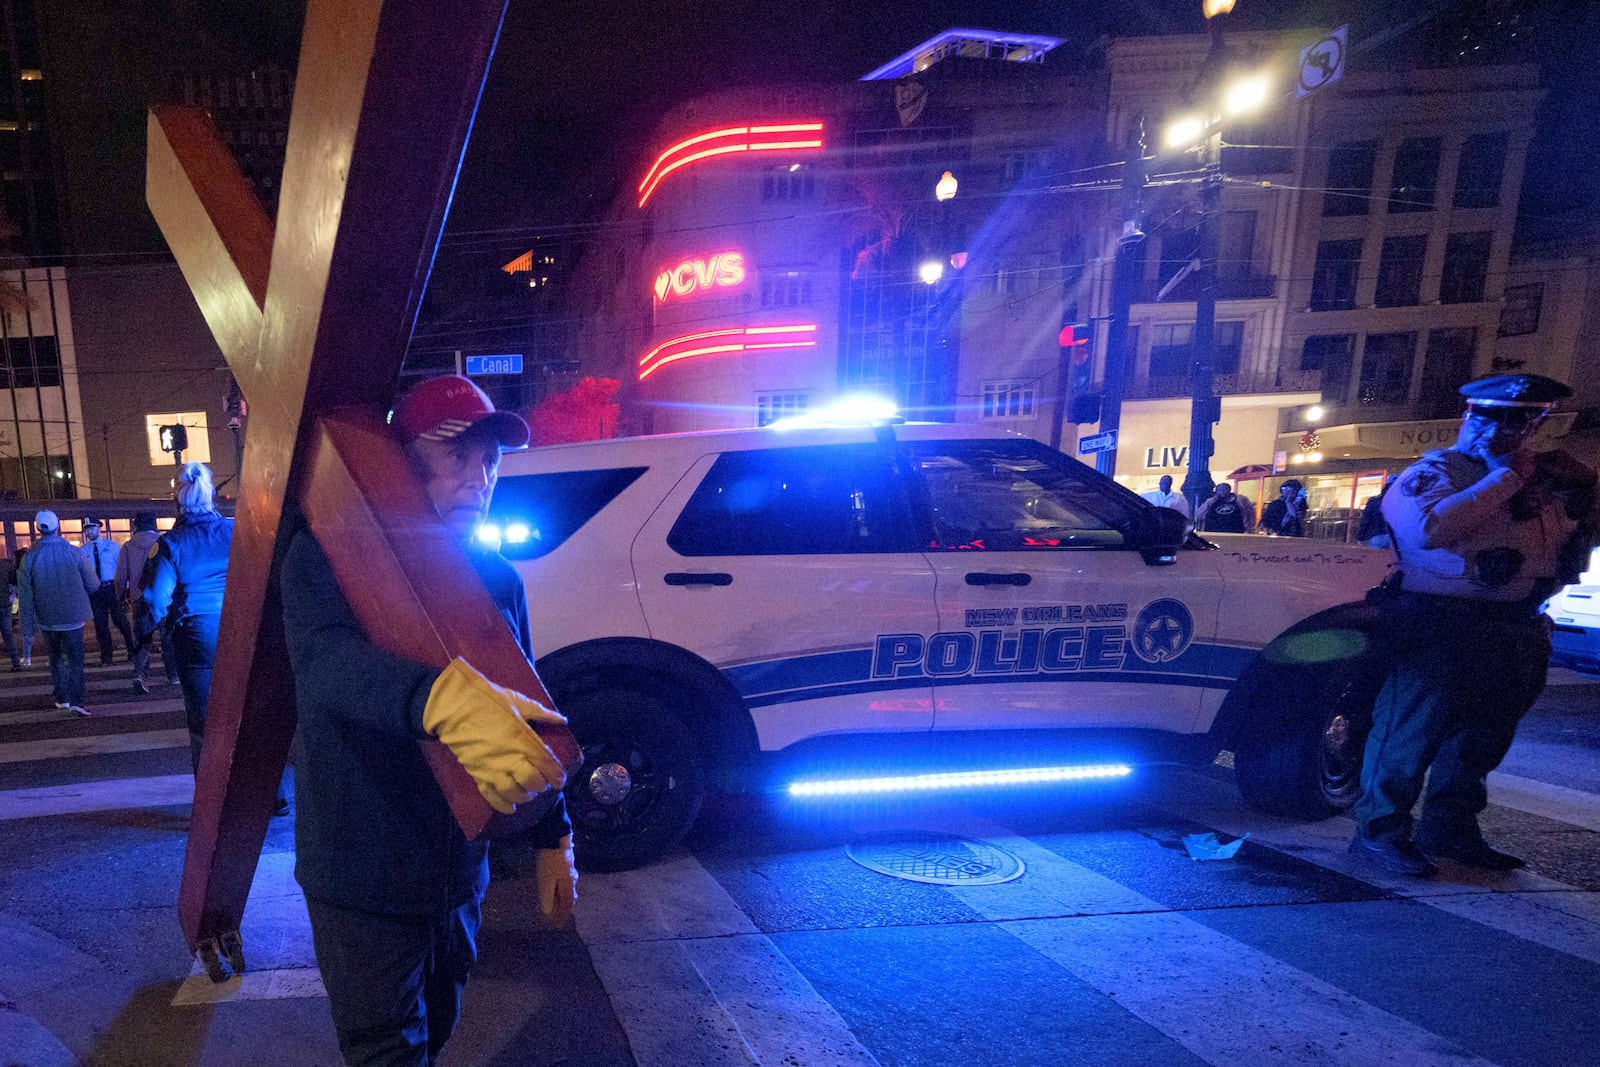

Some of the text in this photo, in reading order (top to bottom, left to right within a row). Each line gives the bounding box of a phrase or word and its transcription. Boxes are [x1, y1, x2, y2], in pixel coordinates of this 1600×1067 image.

[673, 253, 745, 296] CVS
[481, 357, 513, 373] Canal
[1400, 428, 1460, 444] NOU
[1146, 446, 1190, 468] LIV
[965, 603, 1128, 628] NEW ORLEANS
[869, 626, 1128, 680] POLICE
